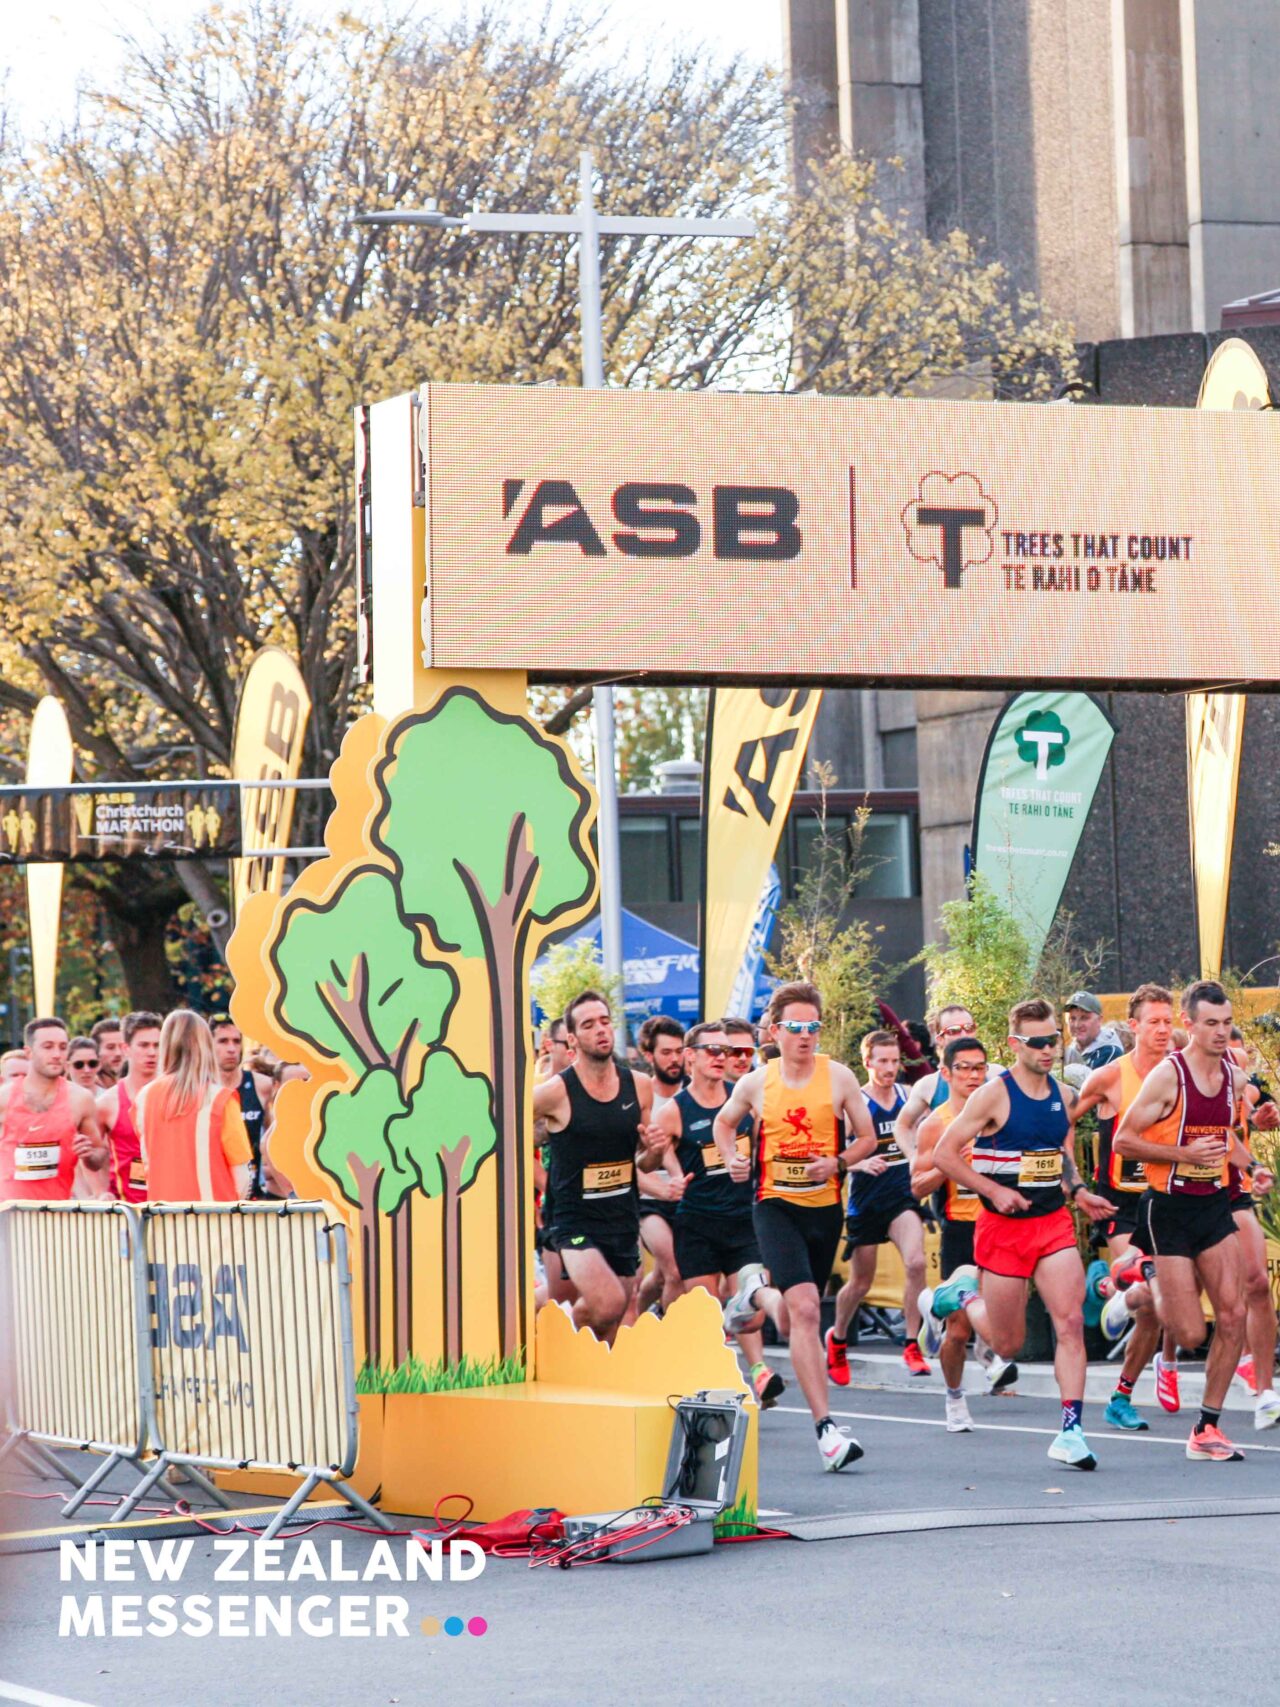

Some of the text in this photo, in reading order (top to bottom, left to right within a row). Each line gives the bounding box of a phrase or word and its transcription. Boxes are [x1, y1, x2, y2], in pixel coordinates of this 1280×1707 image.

[502, 479, 801, 561] ASB
[1001, 532, 1193, 560] TREES THAT COUNT
[1002, 564, 1026, 591] TE
[1032, 565, 1080, 592] RAHI
[1087, 566, 1101, 592] O
[1030, 789, 1052, 802] THAT
[1054, 791, 1082, 804] COUNT
[95, 804, 184, 820] Christchurch
[1009, 803, 1018, 815] TE
[1022, 804, 1042, 816] RAHI
[1045, 806, 1050, 817] O
[95, 818, 185, 834] MARATHON
[27, 1150, 48, 1159] 5138
[598, 1169, 621, 1180] 2244
